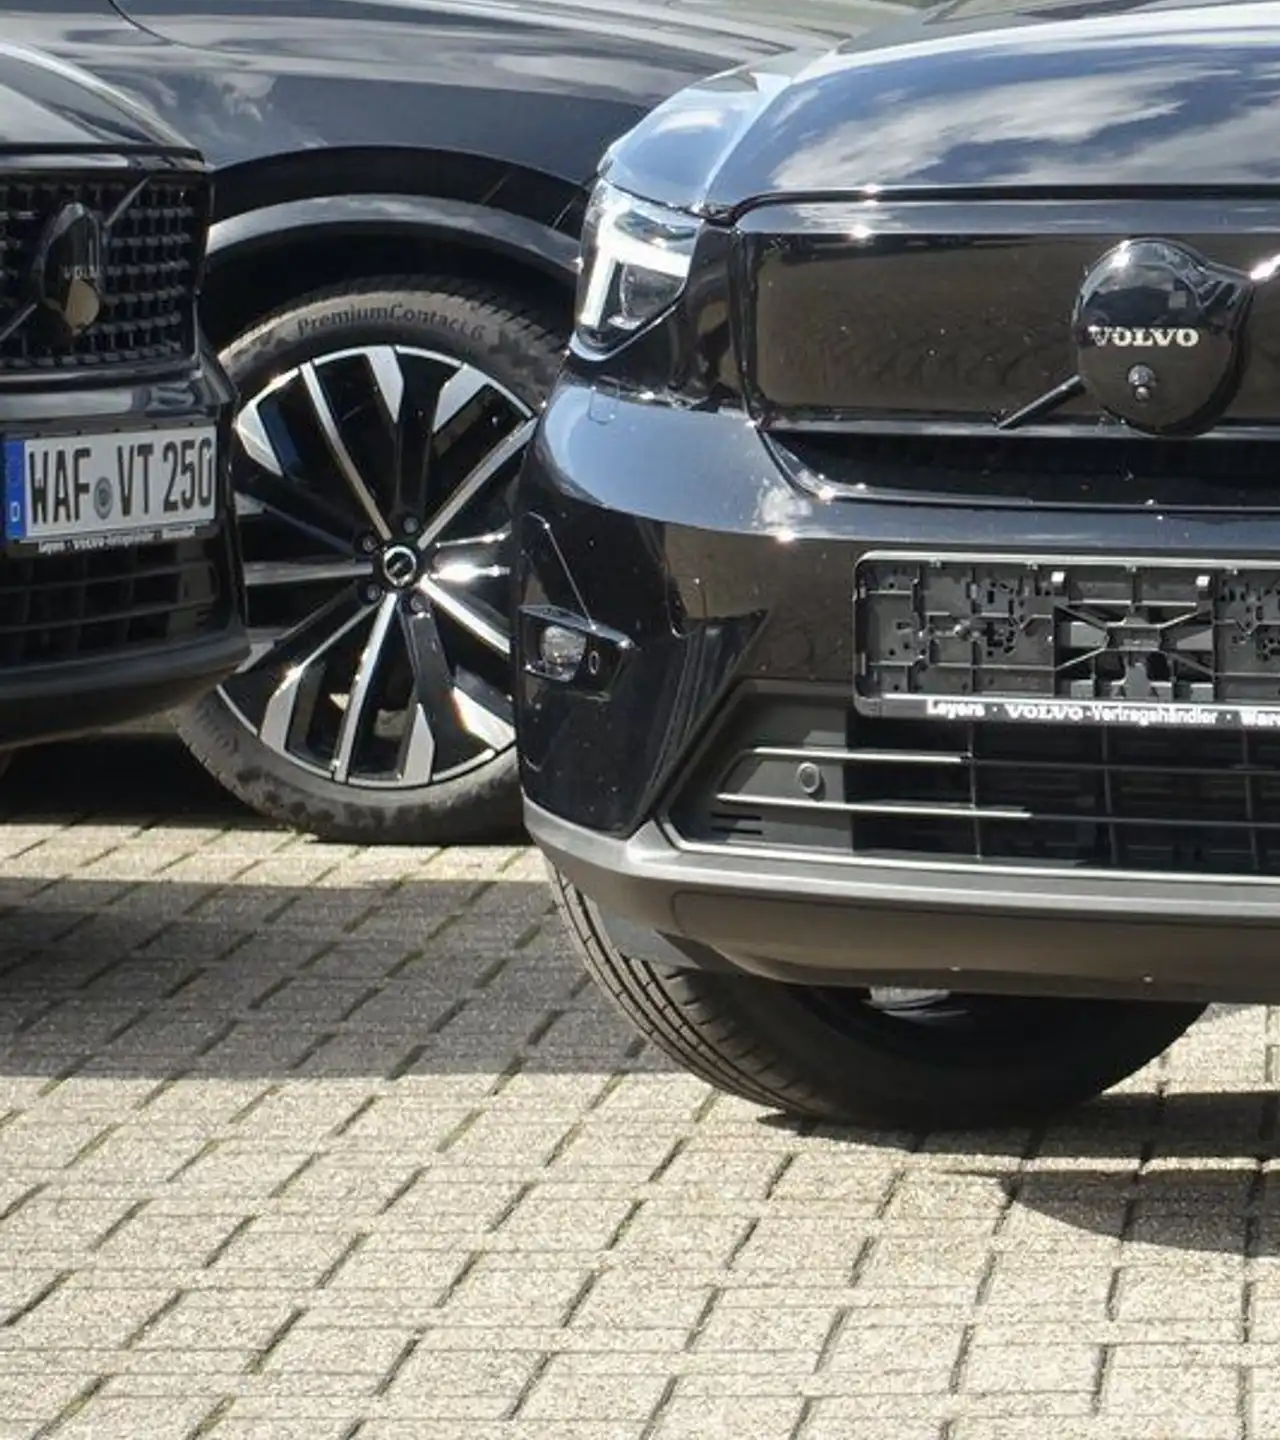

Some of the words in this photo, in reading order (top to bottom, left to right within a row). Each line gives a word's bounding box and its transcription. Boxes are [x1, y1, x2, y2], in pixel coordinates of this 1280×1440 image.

[1087, 325, 1200, 347] VOLVO
[29, 447, 92, 525] WAF
[117, 443, 155, 518] VT
[162, 436, 213, 515] 250
